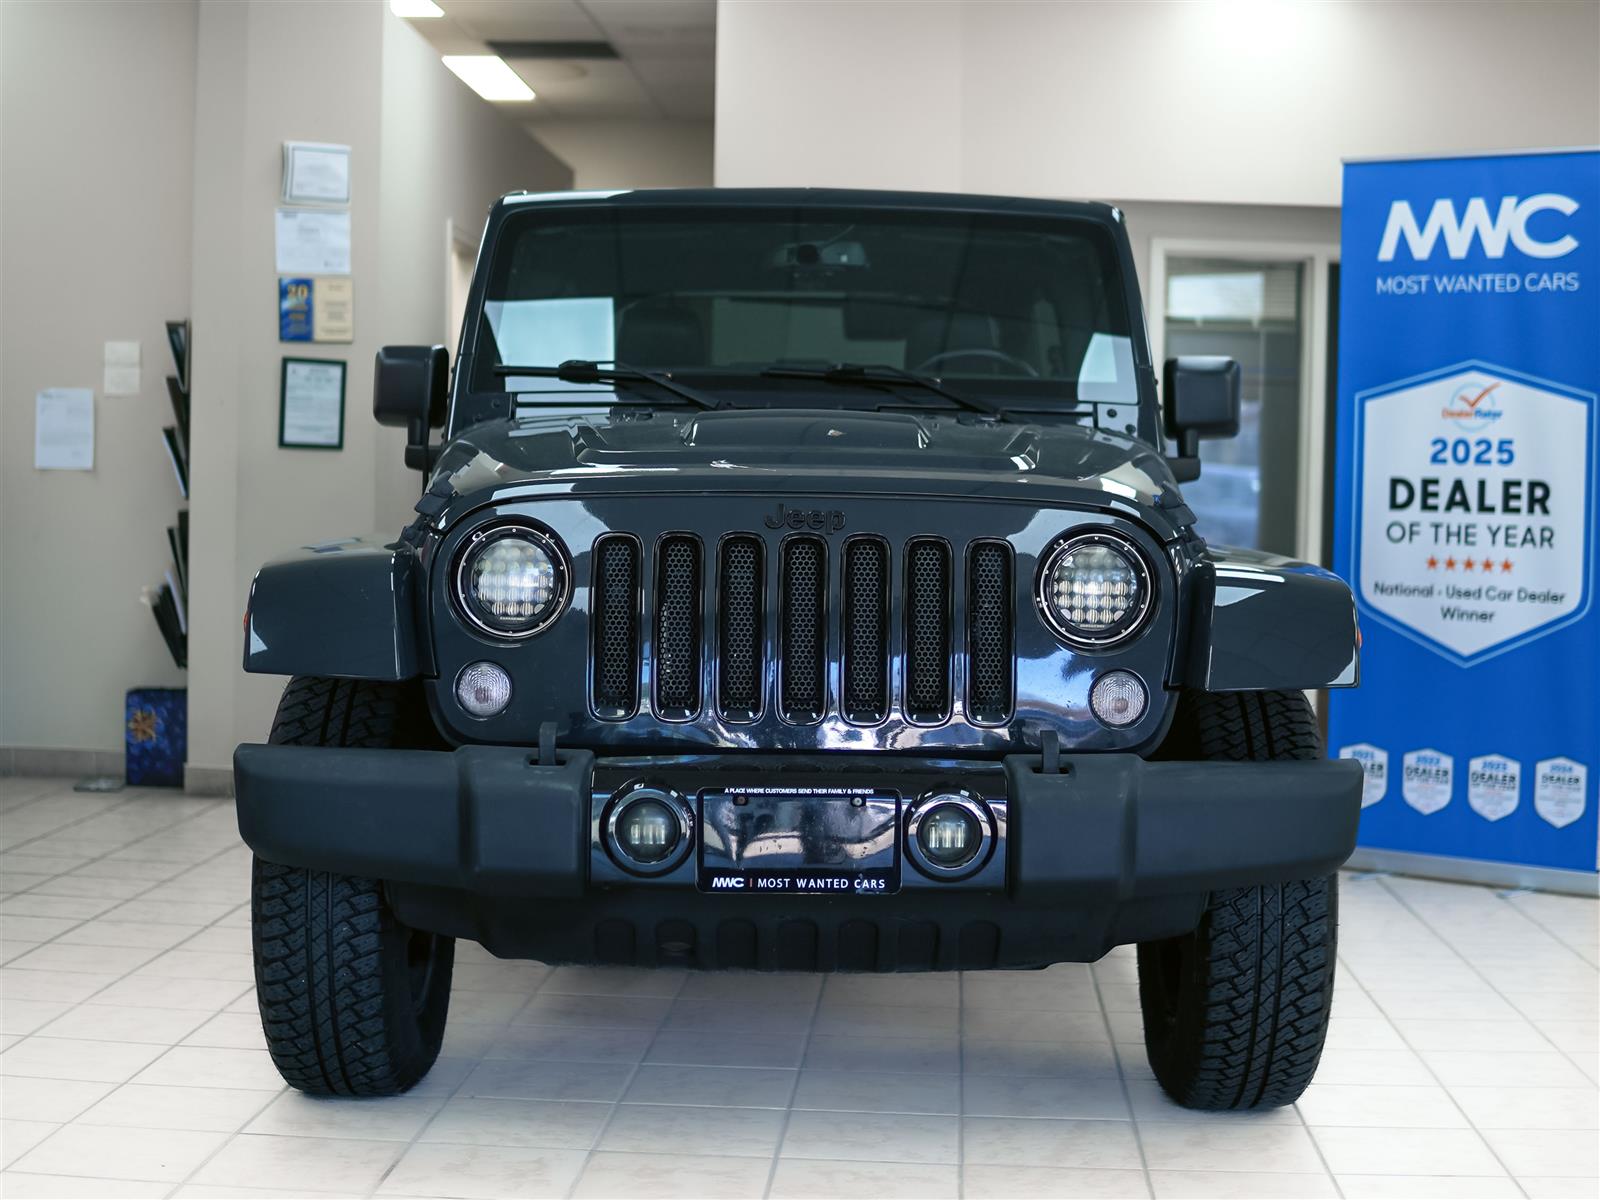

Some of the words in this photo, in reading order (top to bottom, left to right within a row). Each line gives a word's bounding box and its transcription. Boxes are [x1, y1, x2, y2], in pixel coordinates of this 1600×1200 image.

[1377, 192, 1580, 262] MWC
[1376, 275, 1429, 295] MOST
[1434, 273, 1520, 293] WANTED
[1524, 272, 1580, 292] CARS
[1430, 438, 1514, 464] 2025
[1389, 477, 1551, 515] DEALER
[764, 503, 846, 535] Jeep
[1386, 521, 1420, 544] OF
[1430, 522, 1477, 547] THE
[1487, 524, 1555, 549] YEAR
[1373, 581, 1434, 598] National
[1446, 585, 1482, 601] Used
[1485, 586, 1513, 602] Car
[1517, 587, 1566, 604] Dealer
[1440, 605, 1495, 623] Winner
[1405, 766, 1449, 778] DEALER
[1471, 772, 1516, 784] DEALER
[1541, 774, 1580, 785] DEALER
[712, 877, 745, 888] MWC
[757, 878, 791, 888] MOST
[796, 878, 849, 889] WANTED
[854, 879, 886, 889] CARS
